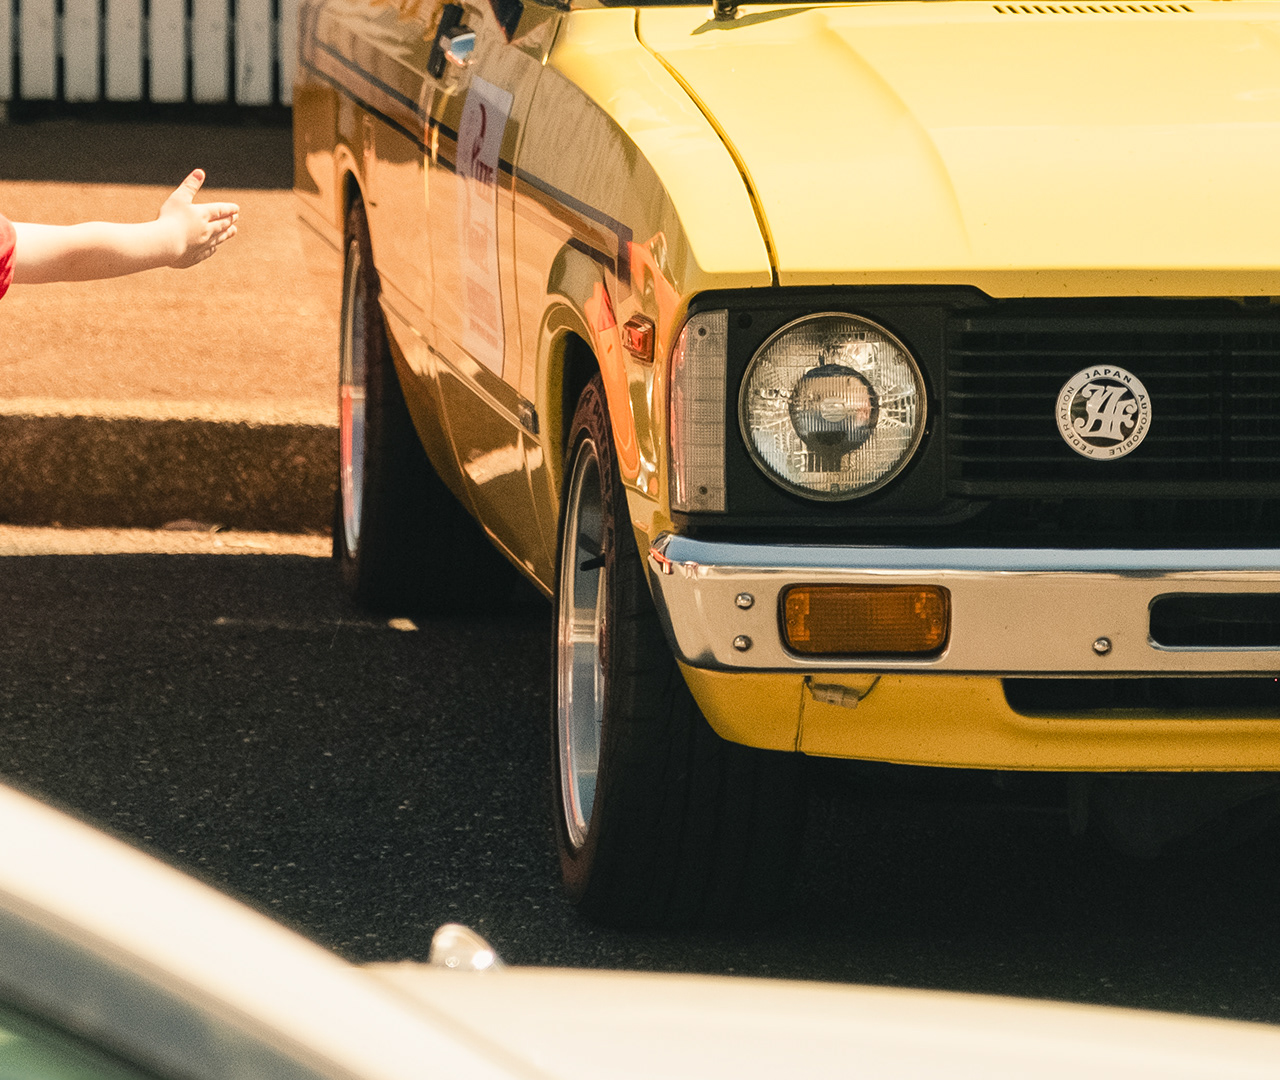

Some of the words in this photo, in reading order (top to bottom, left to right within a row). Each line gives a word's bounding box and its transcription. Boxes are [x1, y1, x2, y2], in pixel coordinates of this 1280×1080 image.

[1084, 368, 1132, 384] JAPAN
[1061, 386, 1095, 455] FEDERATION
[1108, 394, 1148, 456] AUTOMOBILE
